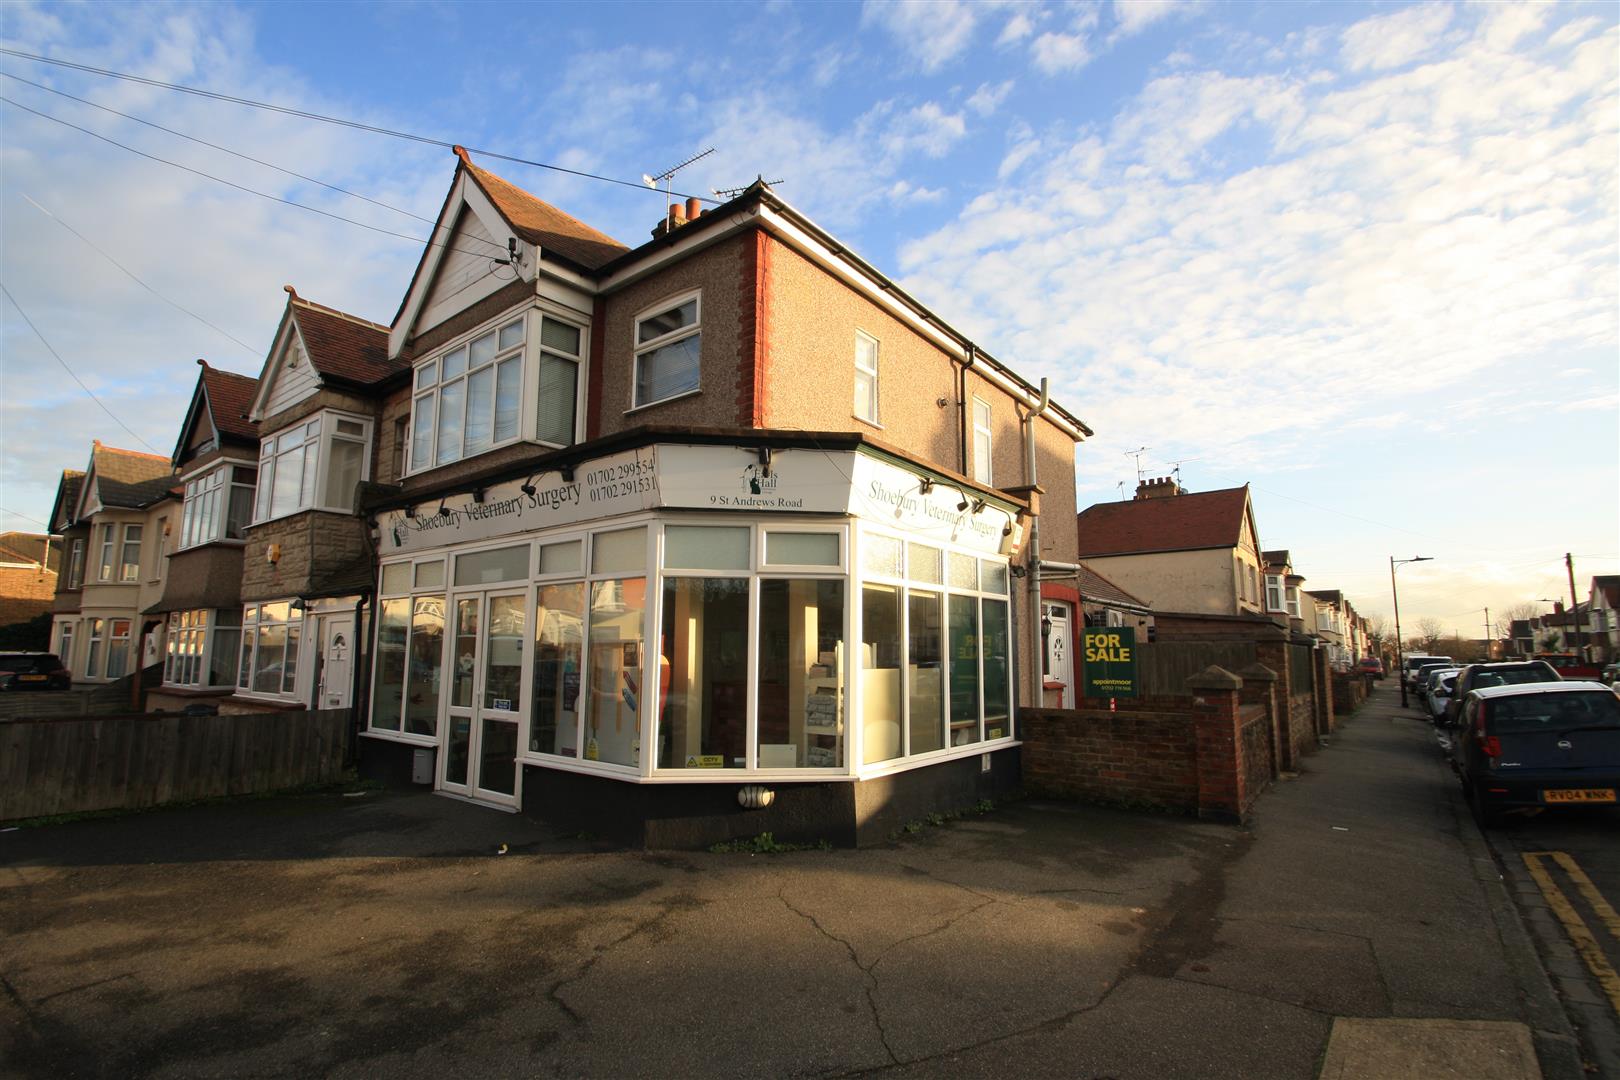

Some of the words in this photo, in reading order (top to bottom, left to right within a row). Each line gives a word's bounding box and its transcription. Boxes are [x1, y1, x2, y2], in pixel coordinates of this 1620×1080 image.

[587, 467, 615, 486] 01702
[590, 484, 619, 502] 01702
[621, 475, 656, 496] 291531
[415, 511, 460, 531] Shoebury
[463, 497, 523, 521] Veterinary
[528, 483, 581, 510] Surgery
[710, 495, 717, 504] 9
[719, 496, 729, 505] St
[732, 496, 775, 507] Andrews
[778, 498, 803, 508] Road
[1085, 634, 1120, 648] FOR
[1086, 648, 1131, 662] SALE
